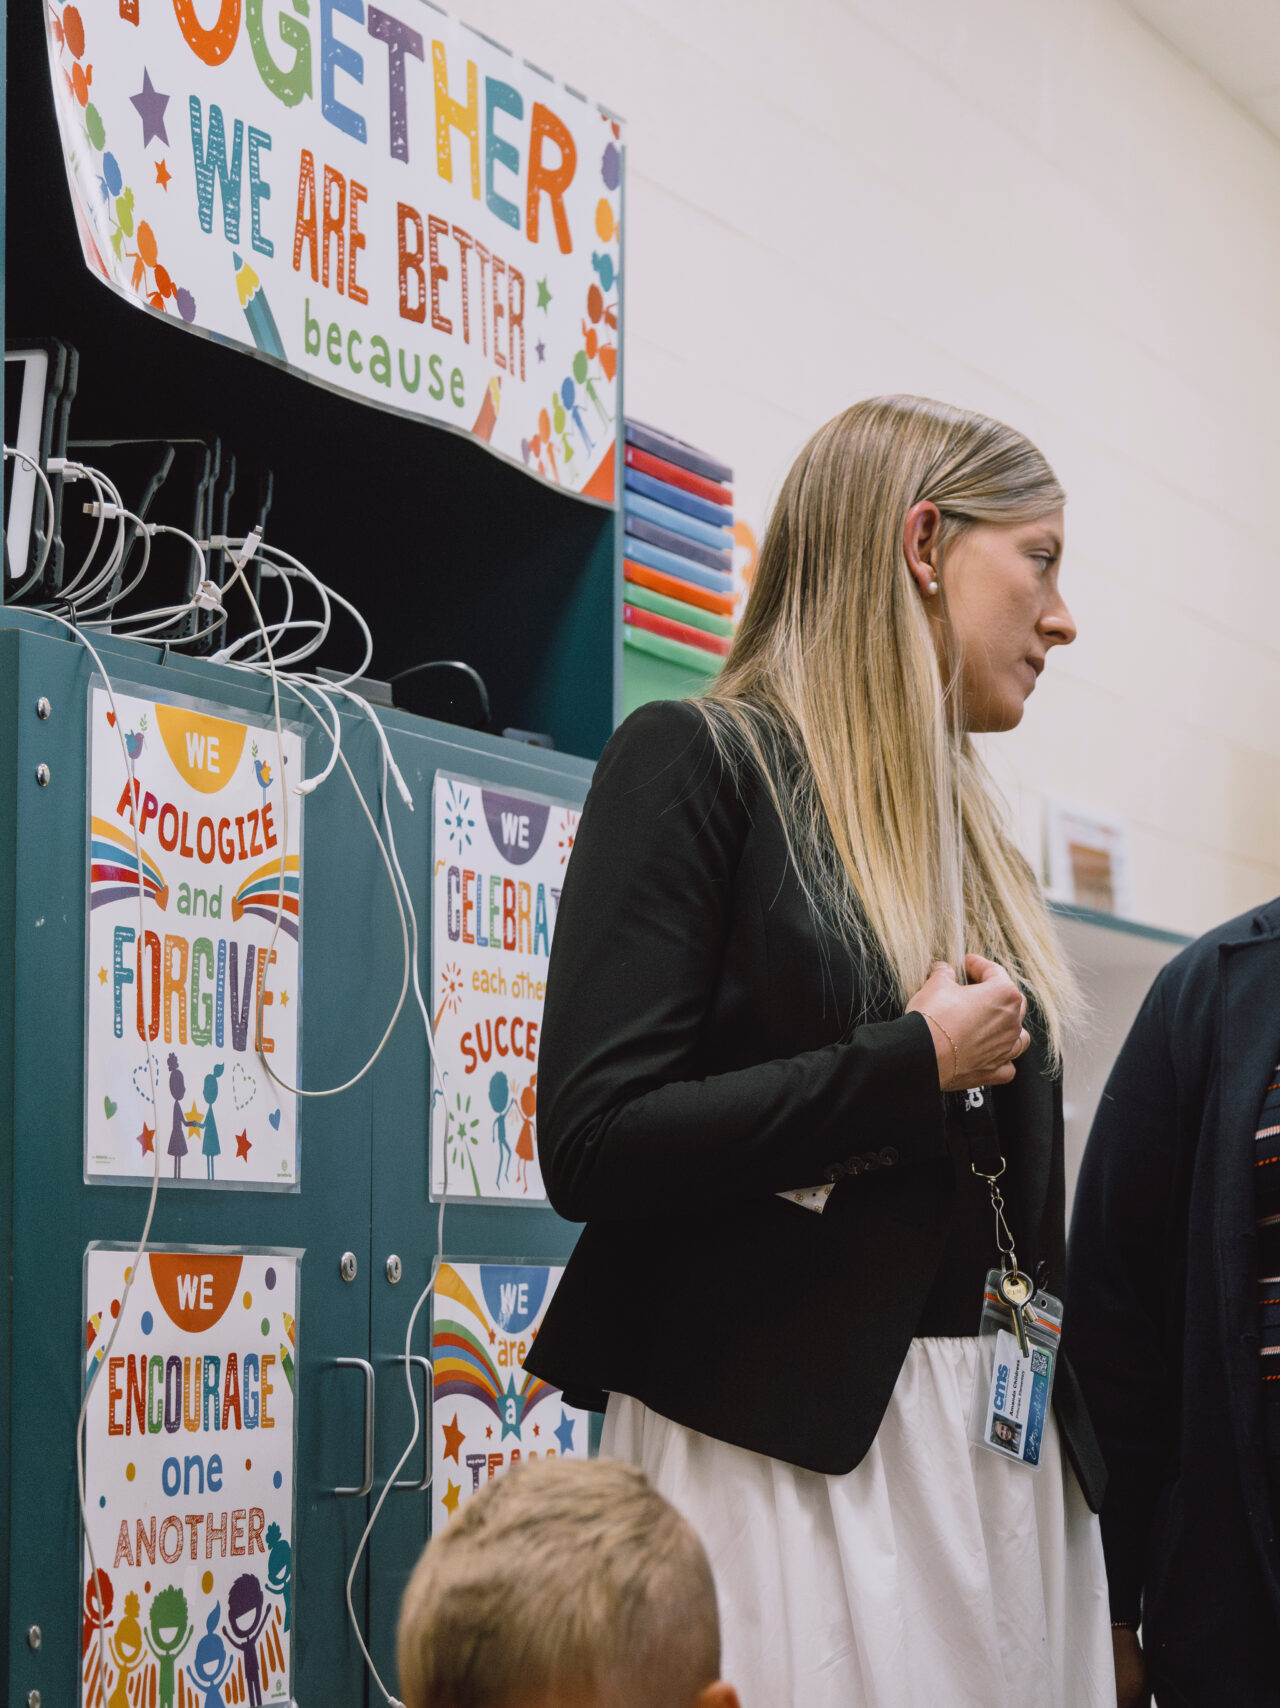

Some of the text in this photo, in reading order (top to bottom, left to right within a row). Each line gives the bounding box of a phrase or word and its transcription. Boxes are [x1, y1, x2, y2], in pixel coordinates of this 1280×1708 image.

[118, 0, 577, 254] GETHER
[189, 95, 526, 382] WE ARE BETTER
[305, 297, 465, 408] because
[185, 731, 221, 774] WE
[116, 776, 278, 864] APOLOGIZE
[500, 811, 531, 850] WE
[176, 882, 222, 919] and
[447, 865, 562, 958] CELEBRA
[113, 925, 277, 1053] FORGIVE
[472, 966, 547, 1001] each othe
[460, 1015, 538, 1075] SUCCE
[176, 1273, 214, 1311] WE
[500, 1282, 529, 1315] WE
[497, 1338, 526, 1367] are
[108, 1352, 276, 1436] ENCOURAGE
[505, 1398, 517, 1425] a
[162, 1453, 223, 1497] one
[113, 1507, 266, 1568] ANOTHER
